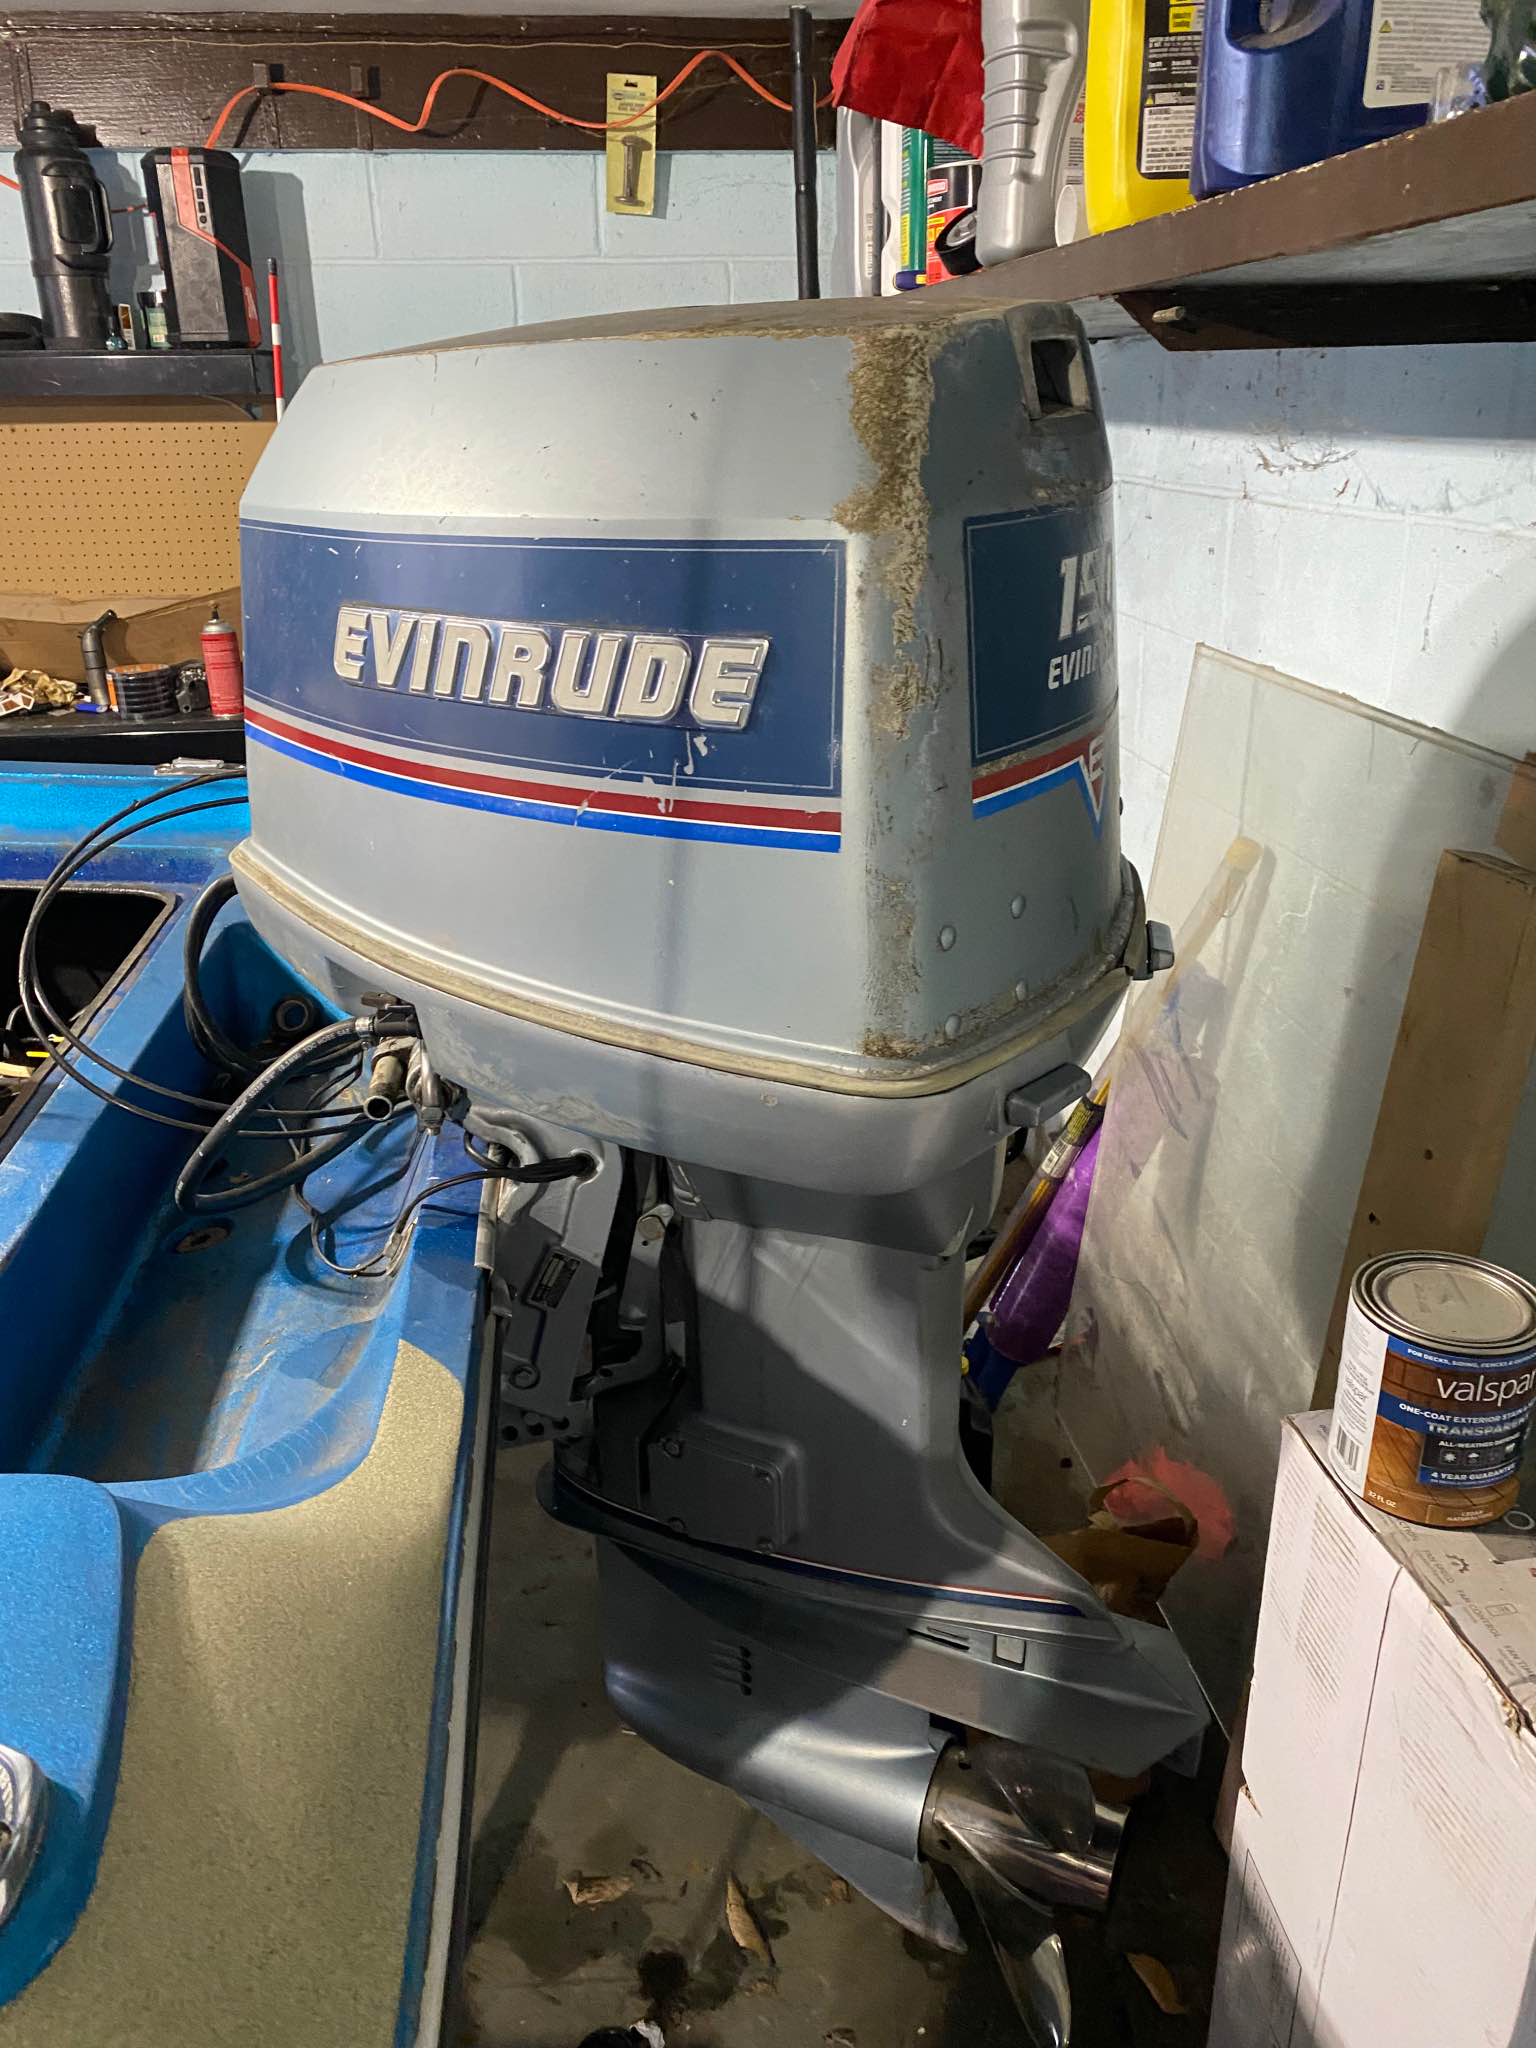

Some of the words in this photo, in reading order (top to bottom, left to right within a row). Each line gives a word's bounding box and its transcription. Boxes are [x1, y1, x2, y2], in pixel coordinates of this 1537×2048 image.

[333, 605, 769, 730] EVINRUDE
[1048, 643, 1098, 690] EVIN
[1408, 1348, 1423, 1358] FOR
[1399, 1402, 1452, 1423] ONE-COAT
[1452, 1415, 1501, 1425] EXTERIOR
[1431, 1471, 1439, 1479] 4
[1440, 1472, 1467, 1481] YEAR
[1377, 1495, 1385, 1504] FL
[1469, 1602, 1501, 1638] CONTROL
